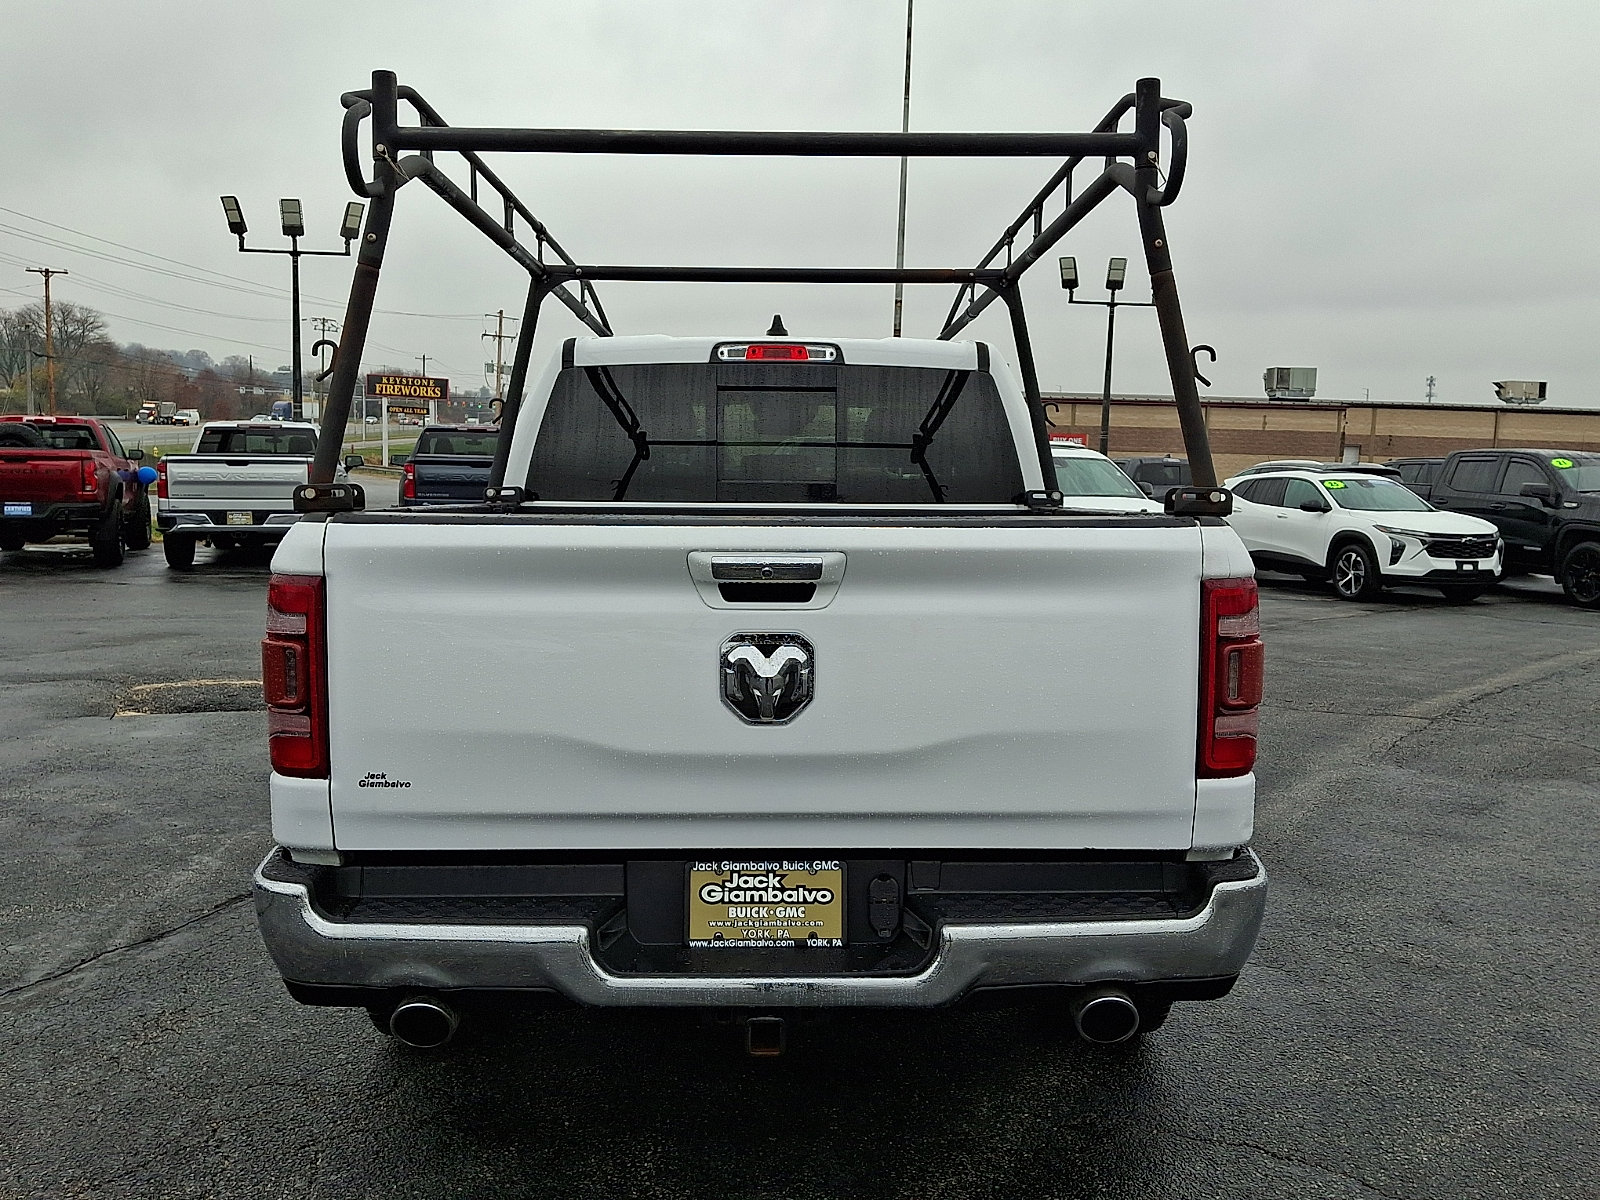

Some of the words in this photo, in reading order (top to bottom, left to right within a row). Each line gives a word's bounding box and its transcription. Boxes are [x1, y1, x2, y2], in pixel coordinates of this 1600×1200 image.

[382, 376, 435, 386] KEYSTONE
[375, 383, 441, 397] FIREWORKS
[176, 471, 298, 480] CHEVROLET
[364, 771, 387, 779] Jack
[358, 779, 412, 788] Giambalvo
[693, 861, 718, 871] Jack
[721, 861, 780, 871] Giambalvo
[783, 861, 810, 871] Buick
[813, 861, 840, 870] GMC
[725, 873, 782, 888] Jack
[701, 885, 832, 902] Giambalvo
[708, 920, 824, 928] www.jackgiambalvo.com
[741, 929, 774, 939] YORK,
[777, 929, 790, 938] PA
[689, 939, 795, 948] www.JackGiambalvo.com
[806, 939, 830, 948] YORK,
[832, 939, 842, 947] PA
